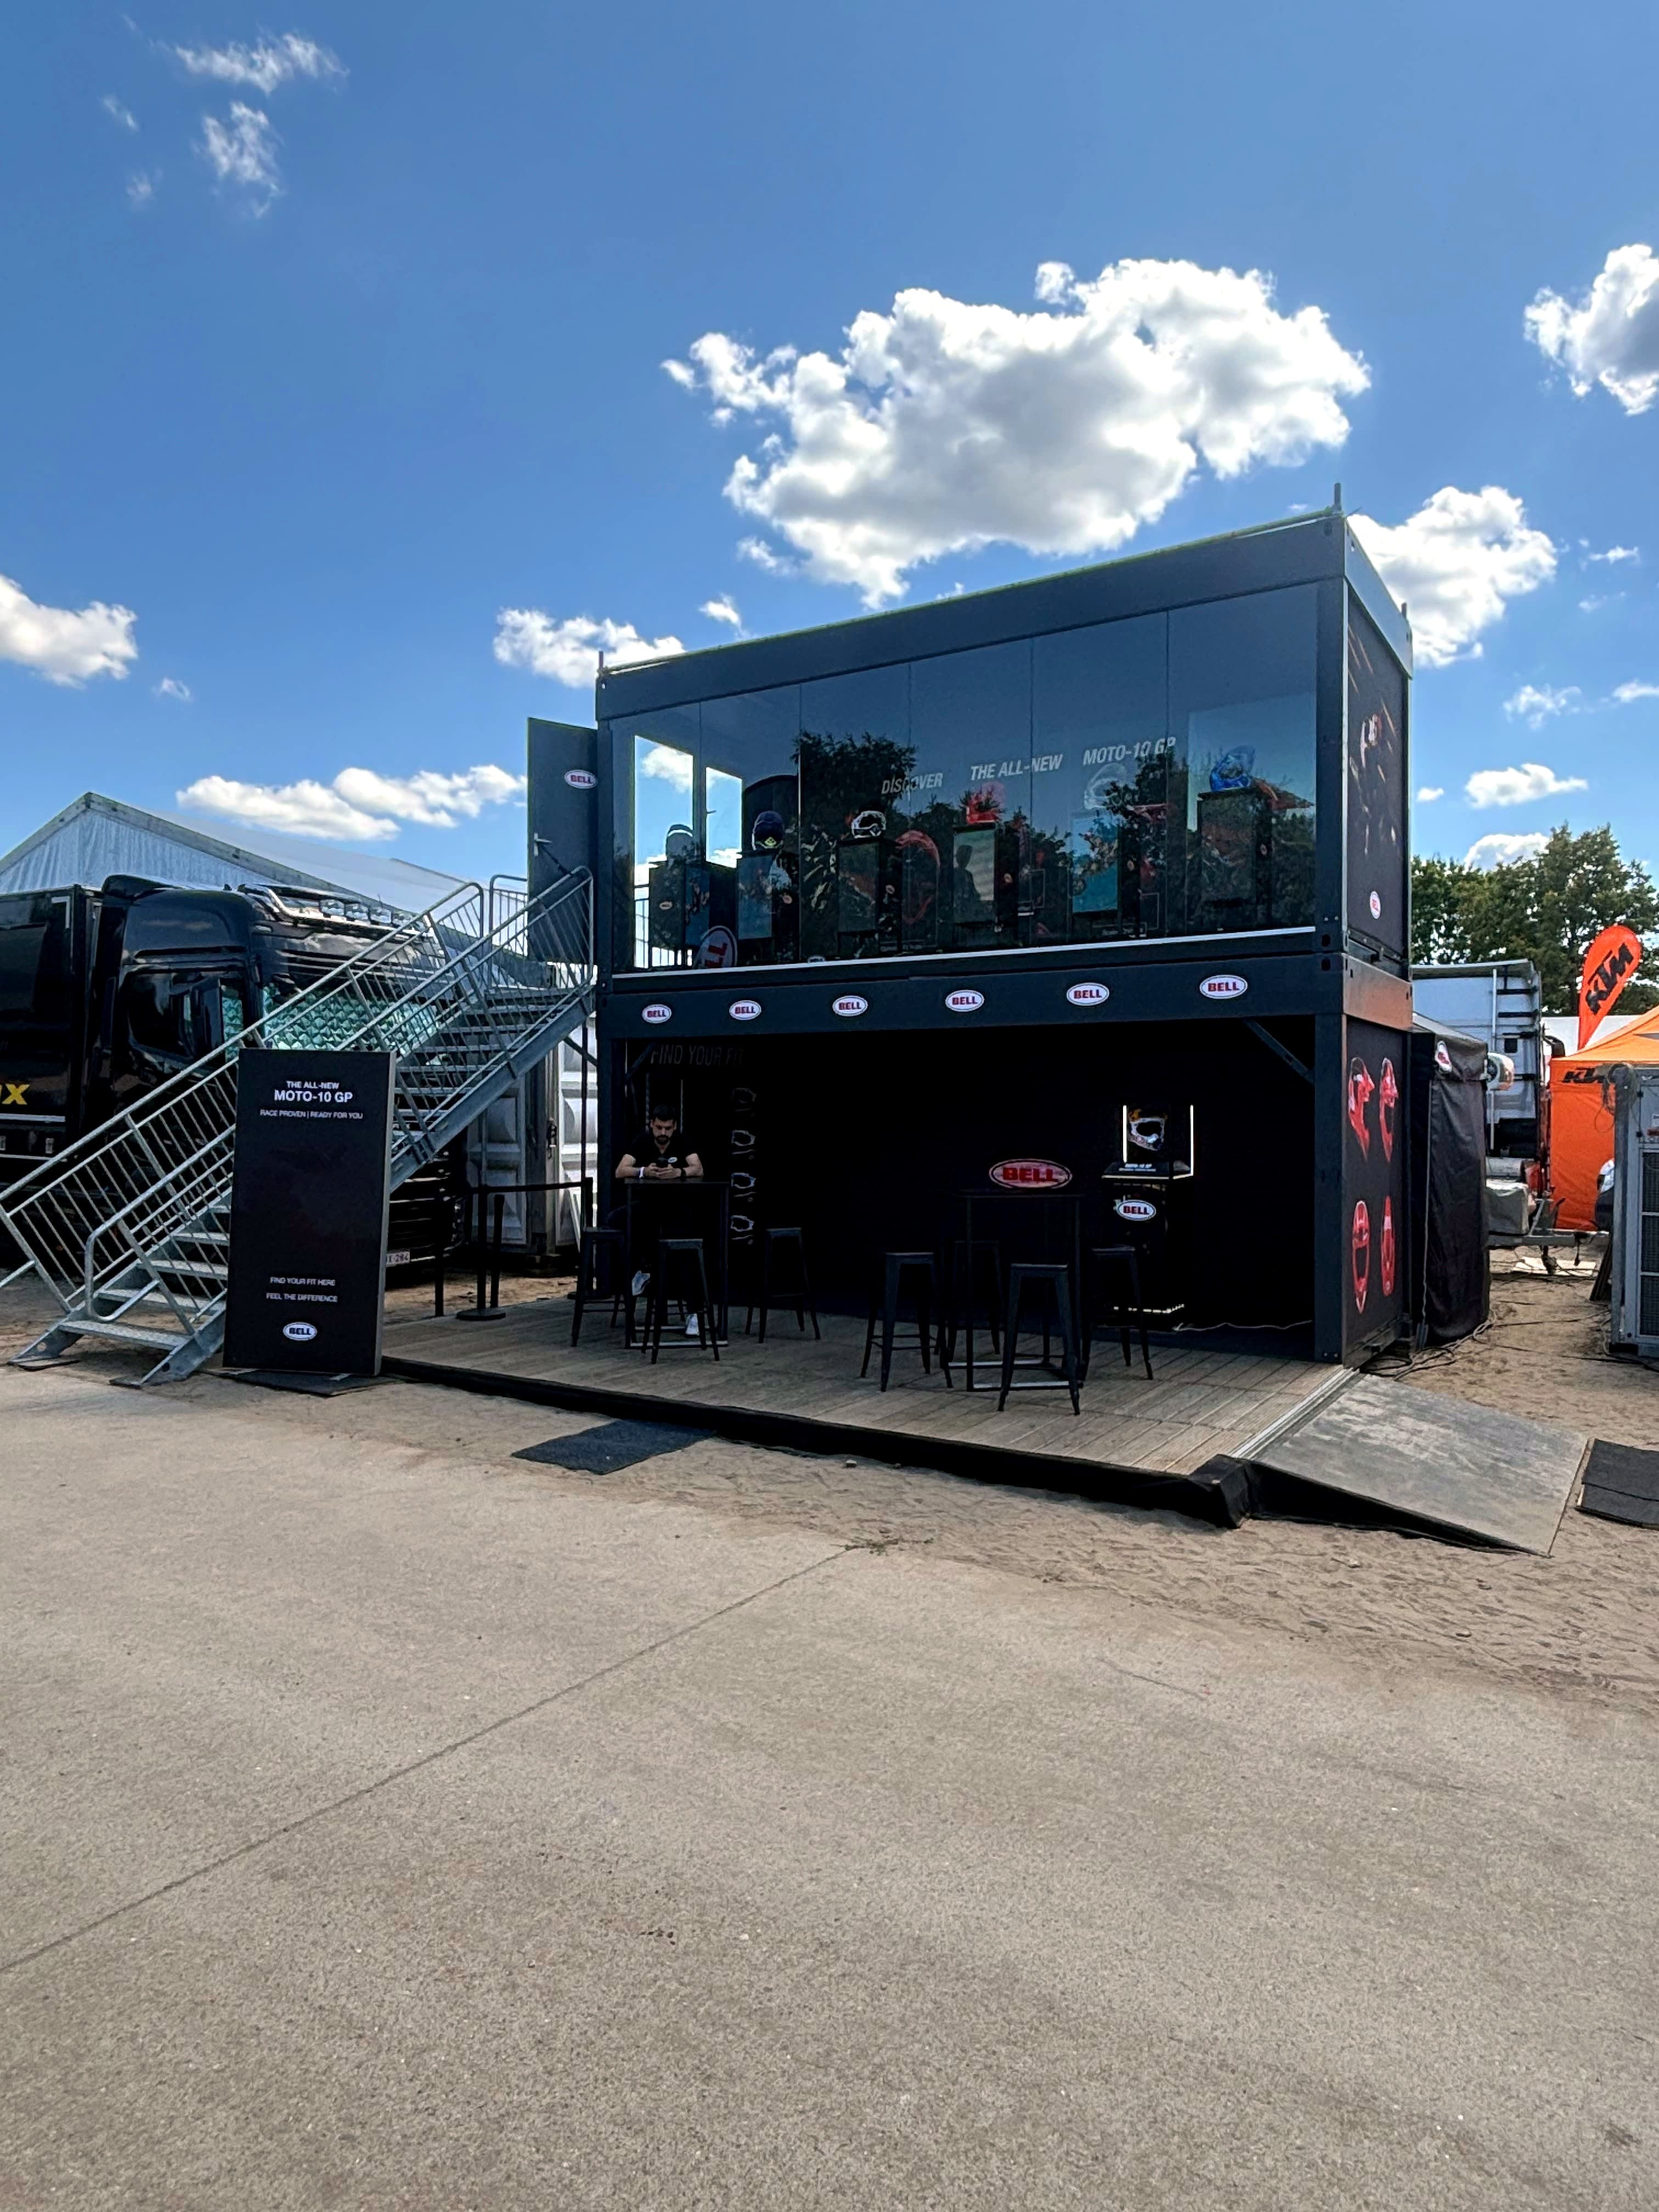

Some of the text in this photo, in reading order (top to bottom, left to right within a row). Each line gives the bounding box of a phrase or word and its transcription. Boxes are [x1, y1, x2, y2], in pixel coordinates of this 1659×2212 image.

[882, 736, 1176, 794] DISCOVER THE ALL-NEW MOTO-10 GP
[571, 775, 592, 784] BELL
[1585, 942, 1634, 1015] KTM
[1207, 981, 1240, 992] BELL
[1073, 989, 1102, 1000] BELL
[838, 1001, 861, 1010] BELL
[952, 996, 978, 1005] BELL
[647, 1010, 667, 1018] BELL
[734, 1006, 756, 1014] BELL
[689, 1045, 723, 1066] YOUR
[0, 1084, 30, 1105] X
[274, 1089, 353, 1103] MOTO-10 GP
[1002, 1167, 1058, 1183] BELL
[1123, 1206, 1150, 1215] BELL
[297, 1294, 338, 1302] DIFFERENCE
